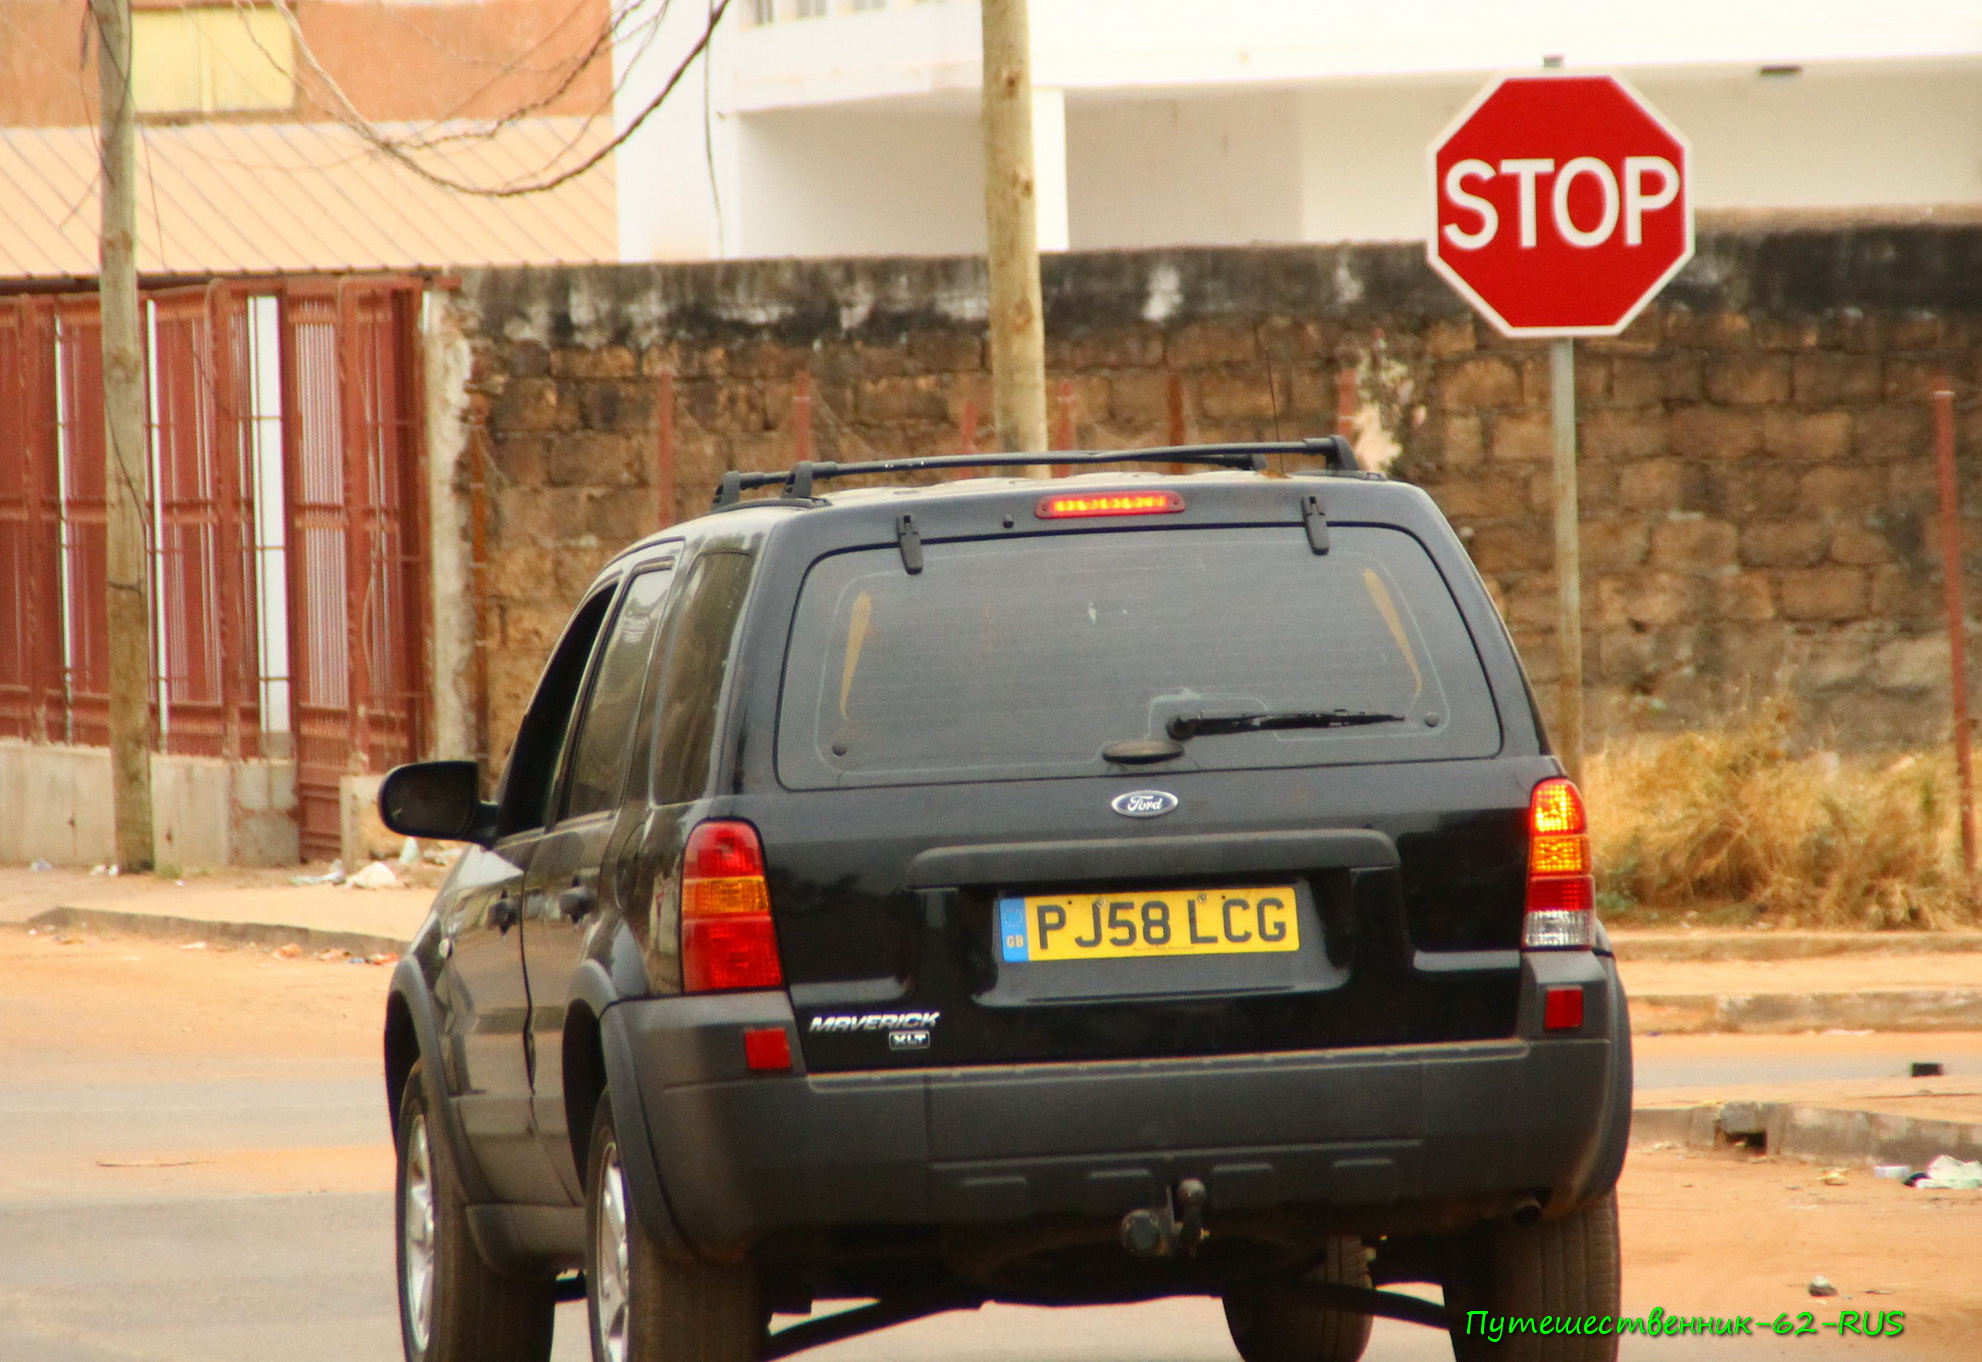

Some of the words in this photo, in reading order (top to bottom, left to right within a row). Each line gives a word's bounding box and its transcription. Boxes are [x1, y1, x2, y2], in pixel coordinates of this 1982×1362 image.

[1444, 156, 1680, 250] STOP
[1127, 795, 1163, 811] Ford
[1036, 899, 1172, 950] PJ58
[1187, 897, 1287, 945] LCG
[1006, 935, 1024, 948] GB
[809, 1011, 941, 1032] MAVERICK
[893, 1033, 926, 1046] XLT
